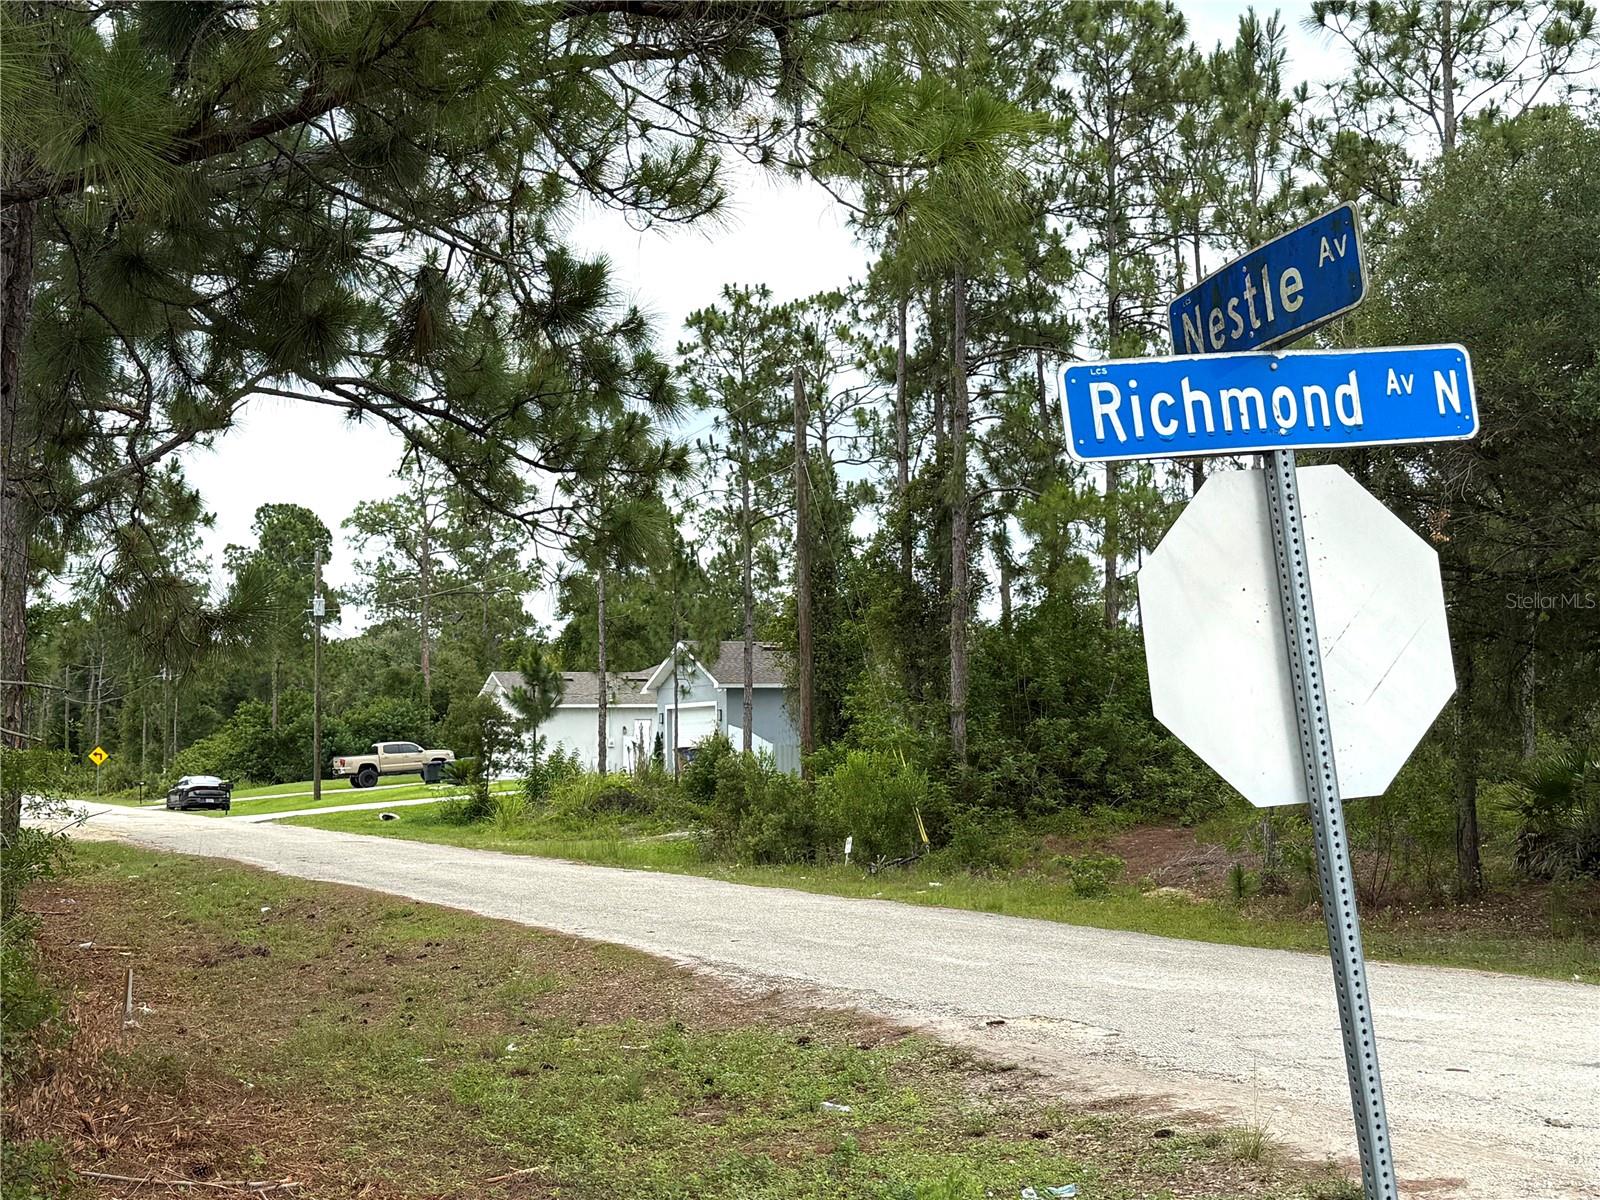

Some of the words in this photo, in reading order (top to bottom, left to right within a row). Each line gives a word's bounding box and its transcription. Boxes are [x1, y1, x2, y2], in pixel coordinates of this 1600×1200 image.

[1182, 264, 1304, 353] Nestle
[1319, 233, 1347, 268] Av
[1089, 369, 1363, 442] Richmond
[1386, 368, 1414, 396] Av
[1433, 369, 1461, 416] N
[1090, 367, 1108, 376] LCS
